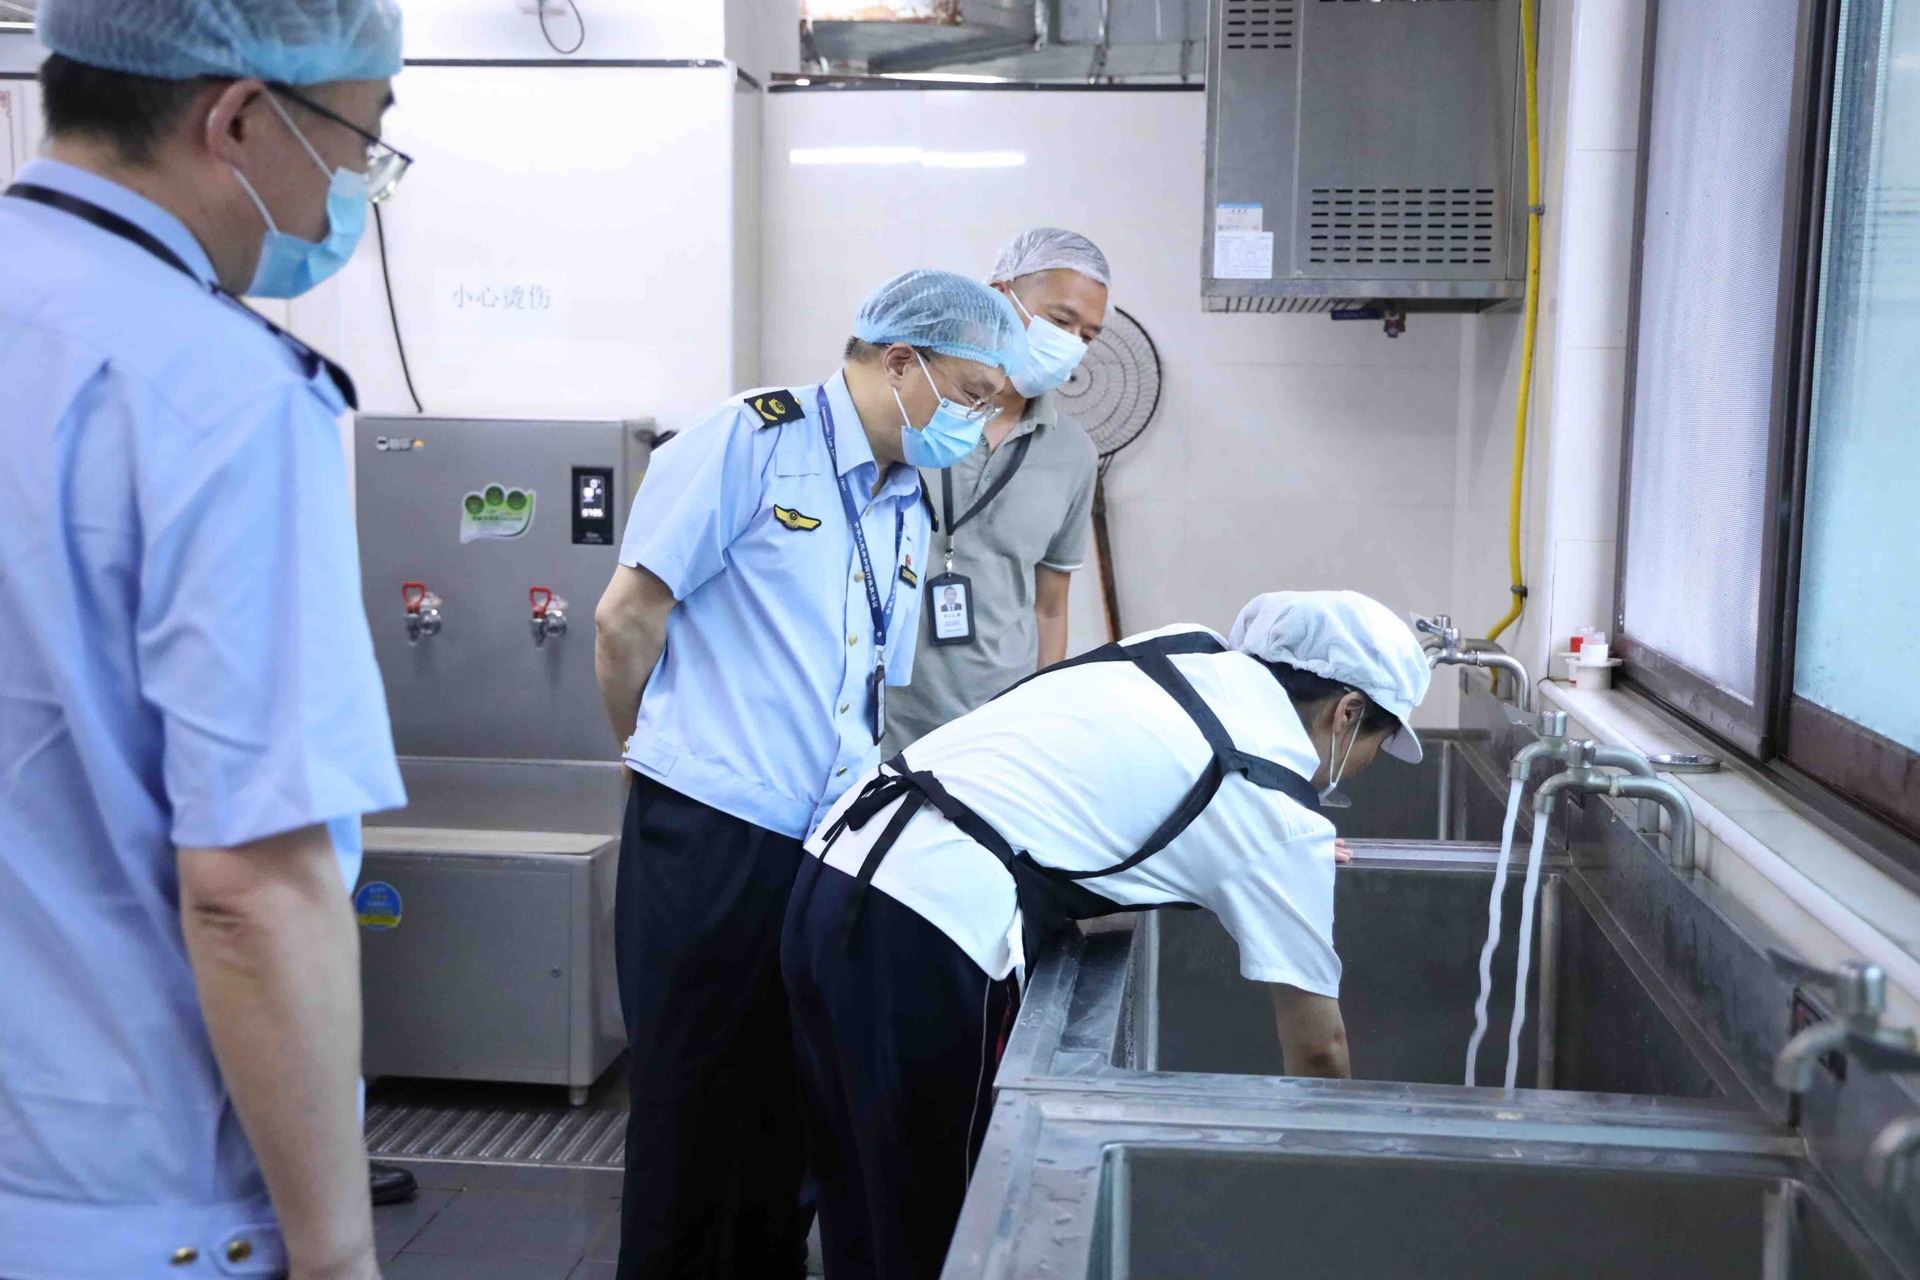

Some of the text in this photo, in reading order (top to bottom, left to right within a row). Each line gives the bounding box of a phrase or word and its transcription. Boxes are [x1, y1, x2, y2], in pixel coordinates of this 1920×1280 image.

[854, 521, 878, 609] 中华人民共和国行政执法证
